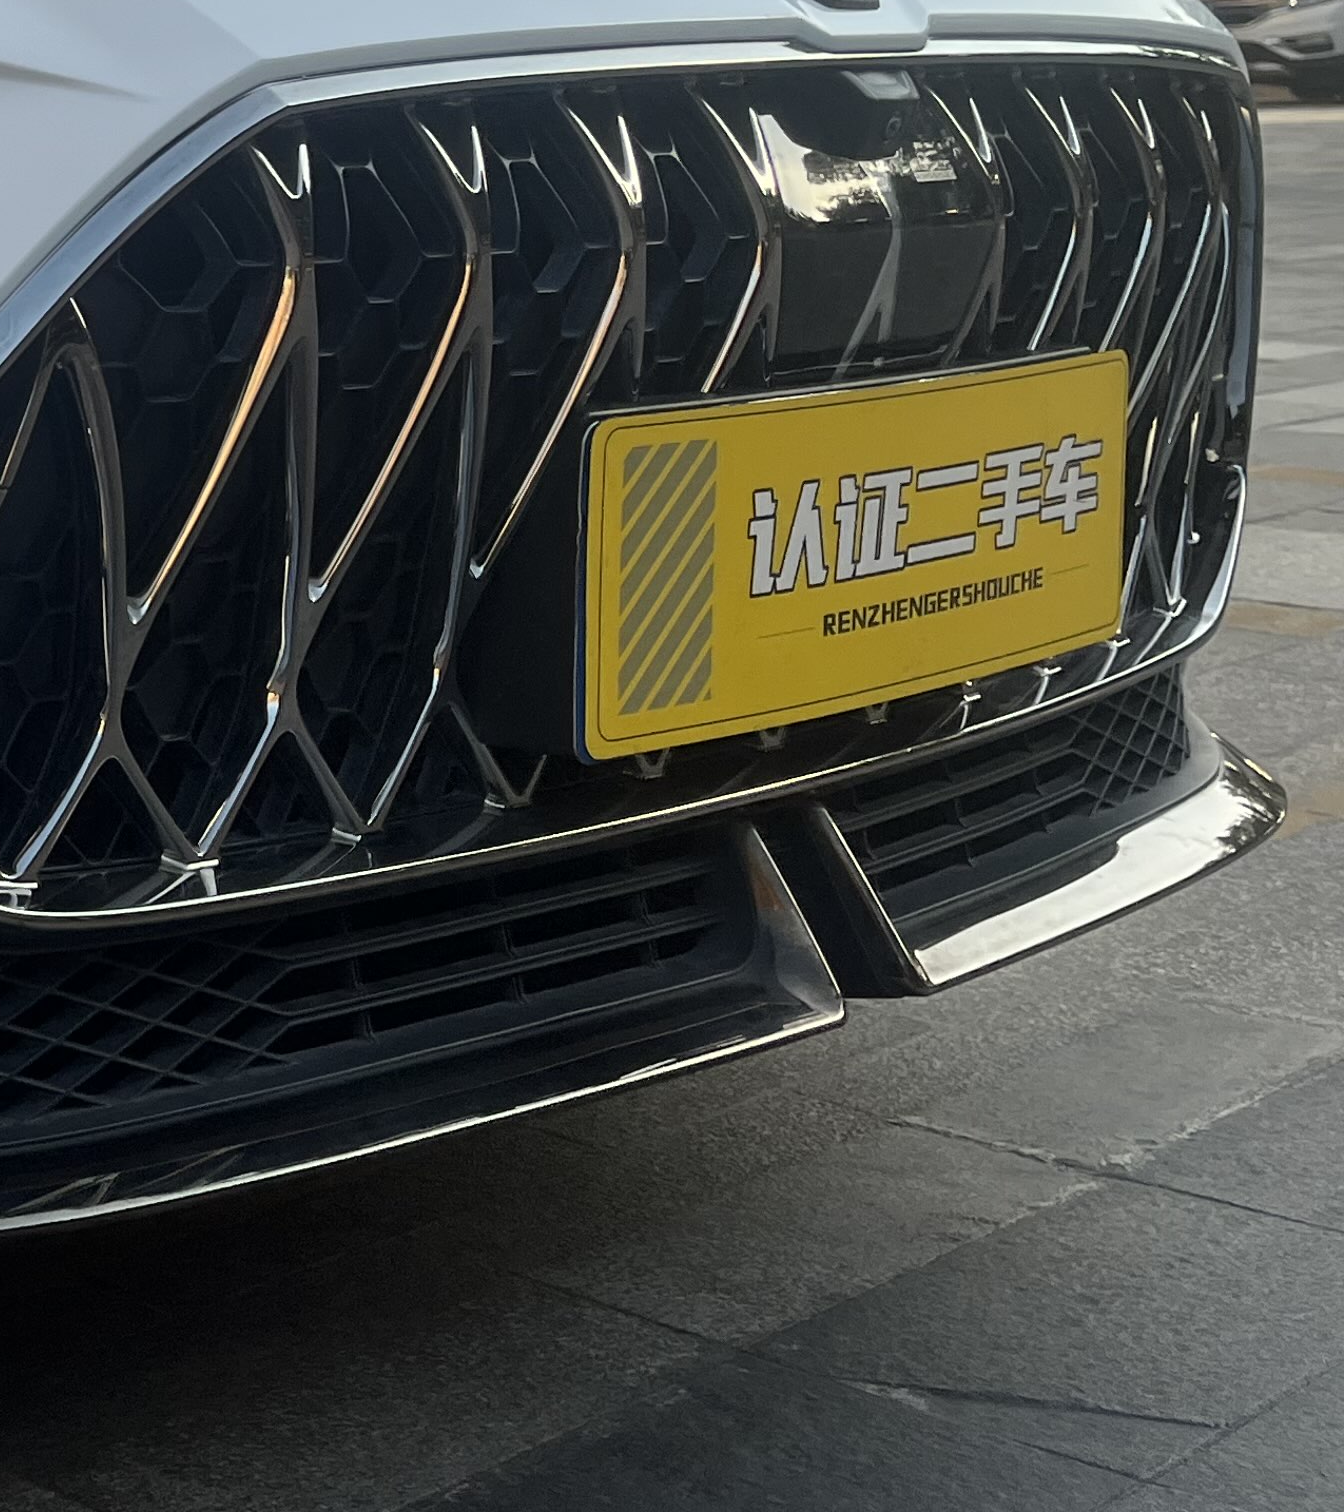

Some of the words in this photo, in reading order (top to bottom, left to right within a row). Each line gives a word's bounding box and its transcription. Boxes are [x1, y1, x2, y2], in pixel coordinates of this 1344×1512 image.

[748, 434, 1104, 599] 认证二手车
[822, 566, 1045, 637] RENZHENGERSHOUCHE
